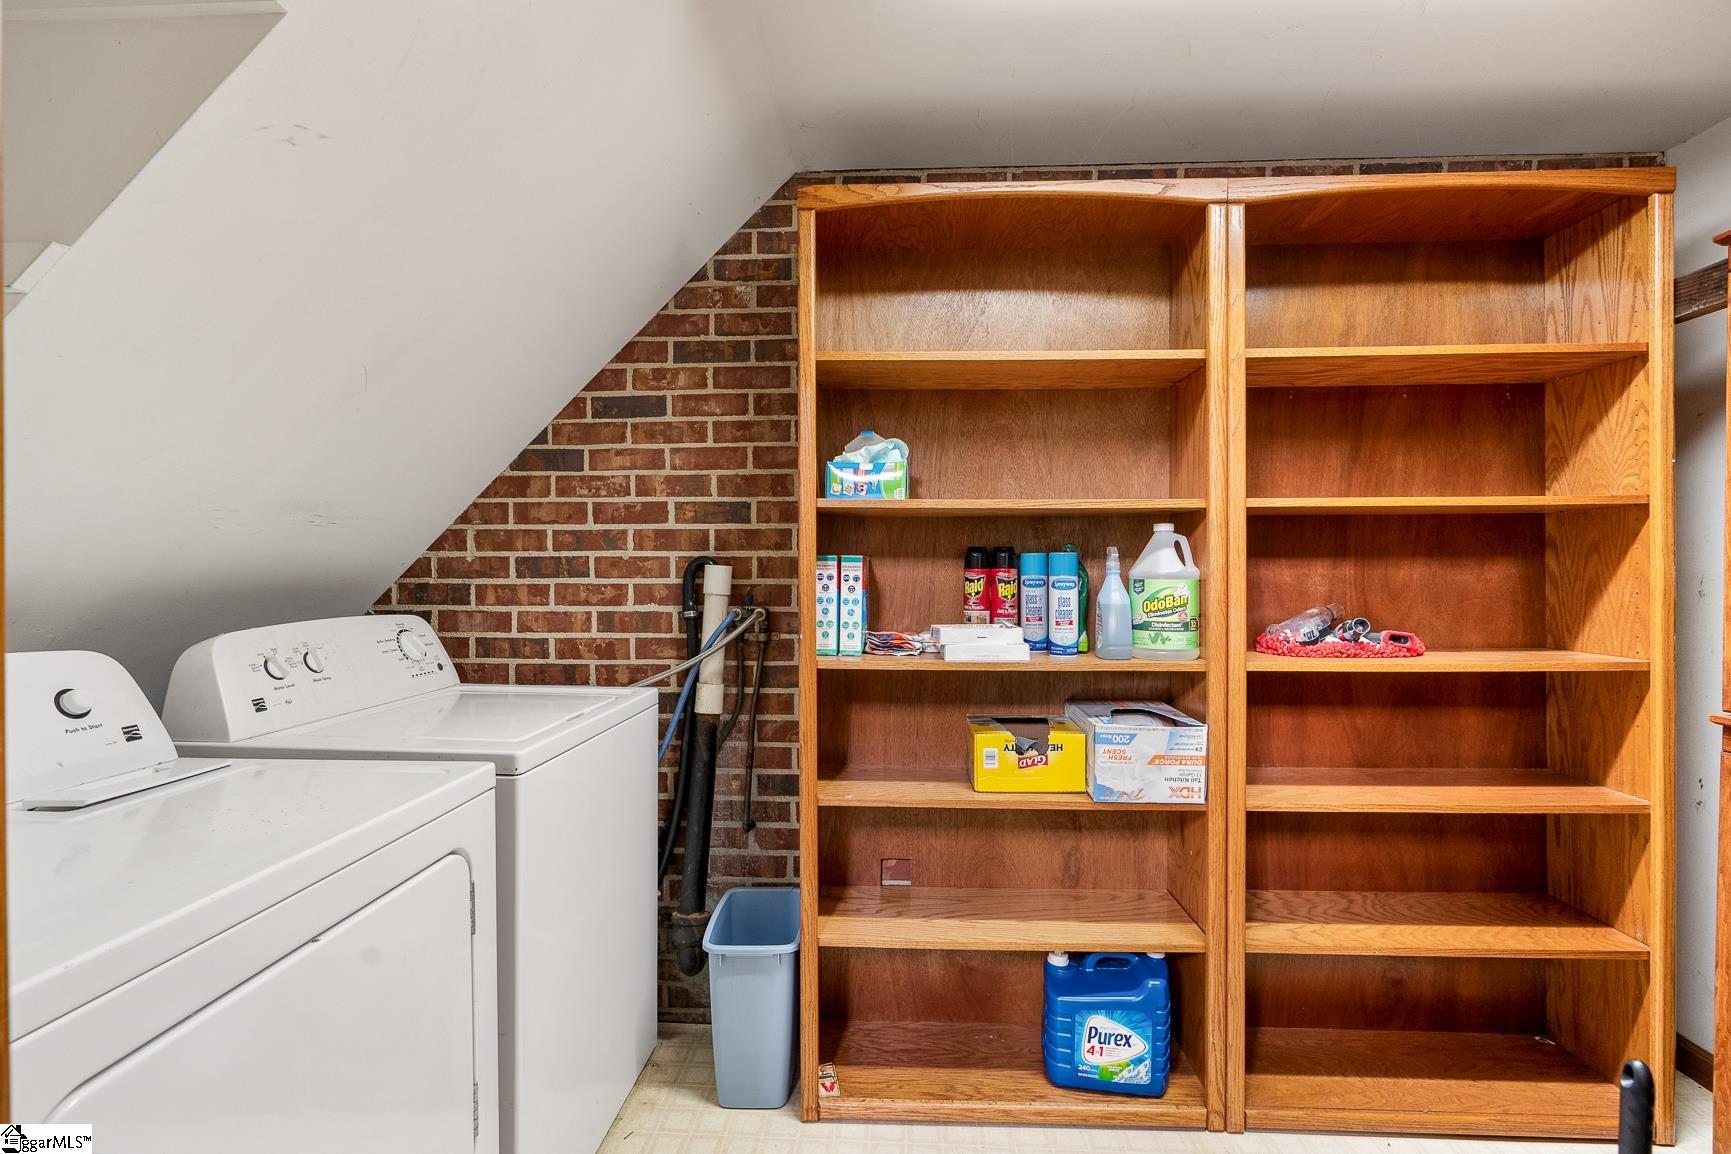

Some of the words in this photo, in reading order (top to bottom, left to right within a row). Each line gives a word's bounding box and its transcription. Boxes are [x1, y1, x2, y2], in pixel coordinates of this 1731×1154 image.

[964, 578, 984, 594] Raid
[998, 580, 1018, 597] Raid
[1057, 596, 1071, 608] glass
[1143, 595, 1188, 613] OdoBan
[1055, 608, 1074, 619] cleaner
[1112, 734, 1130, 744] 200
[1019, 755, 1047, 767] GLAD
[1168, 786, 1202, 799] HDX
[1087, 1026, 1132, 1048] Purex
